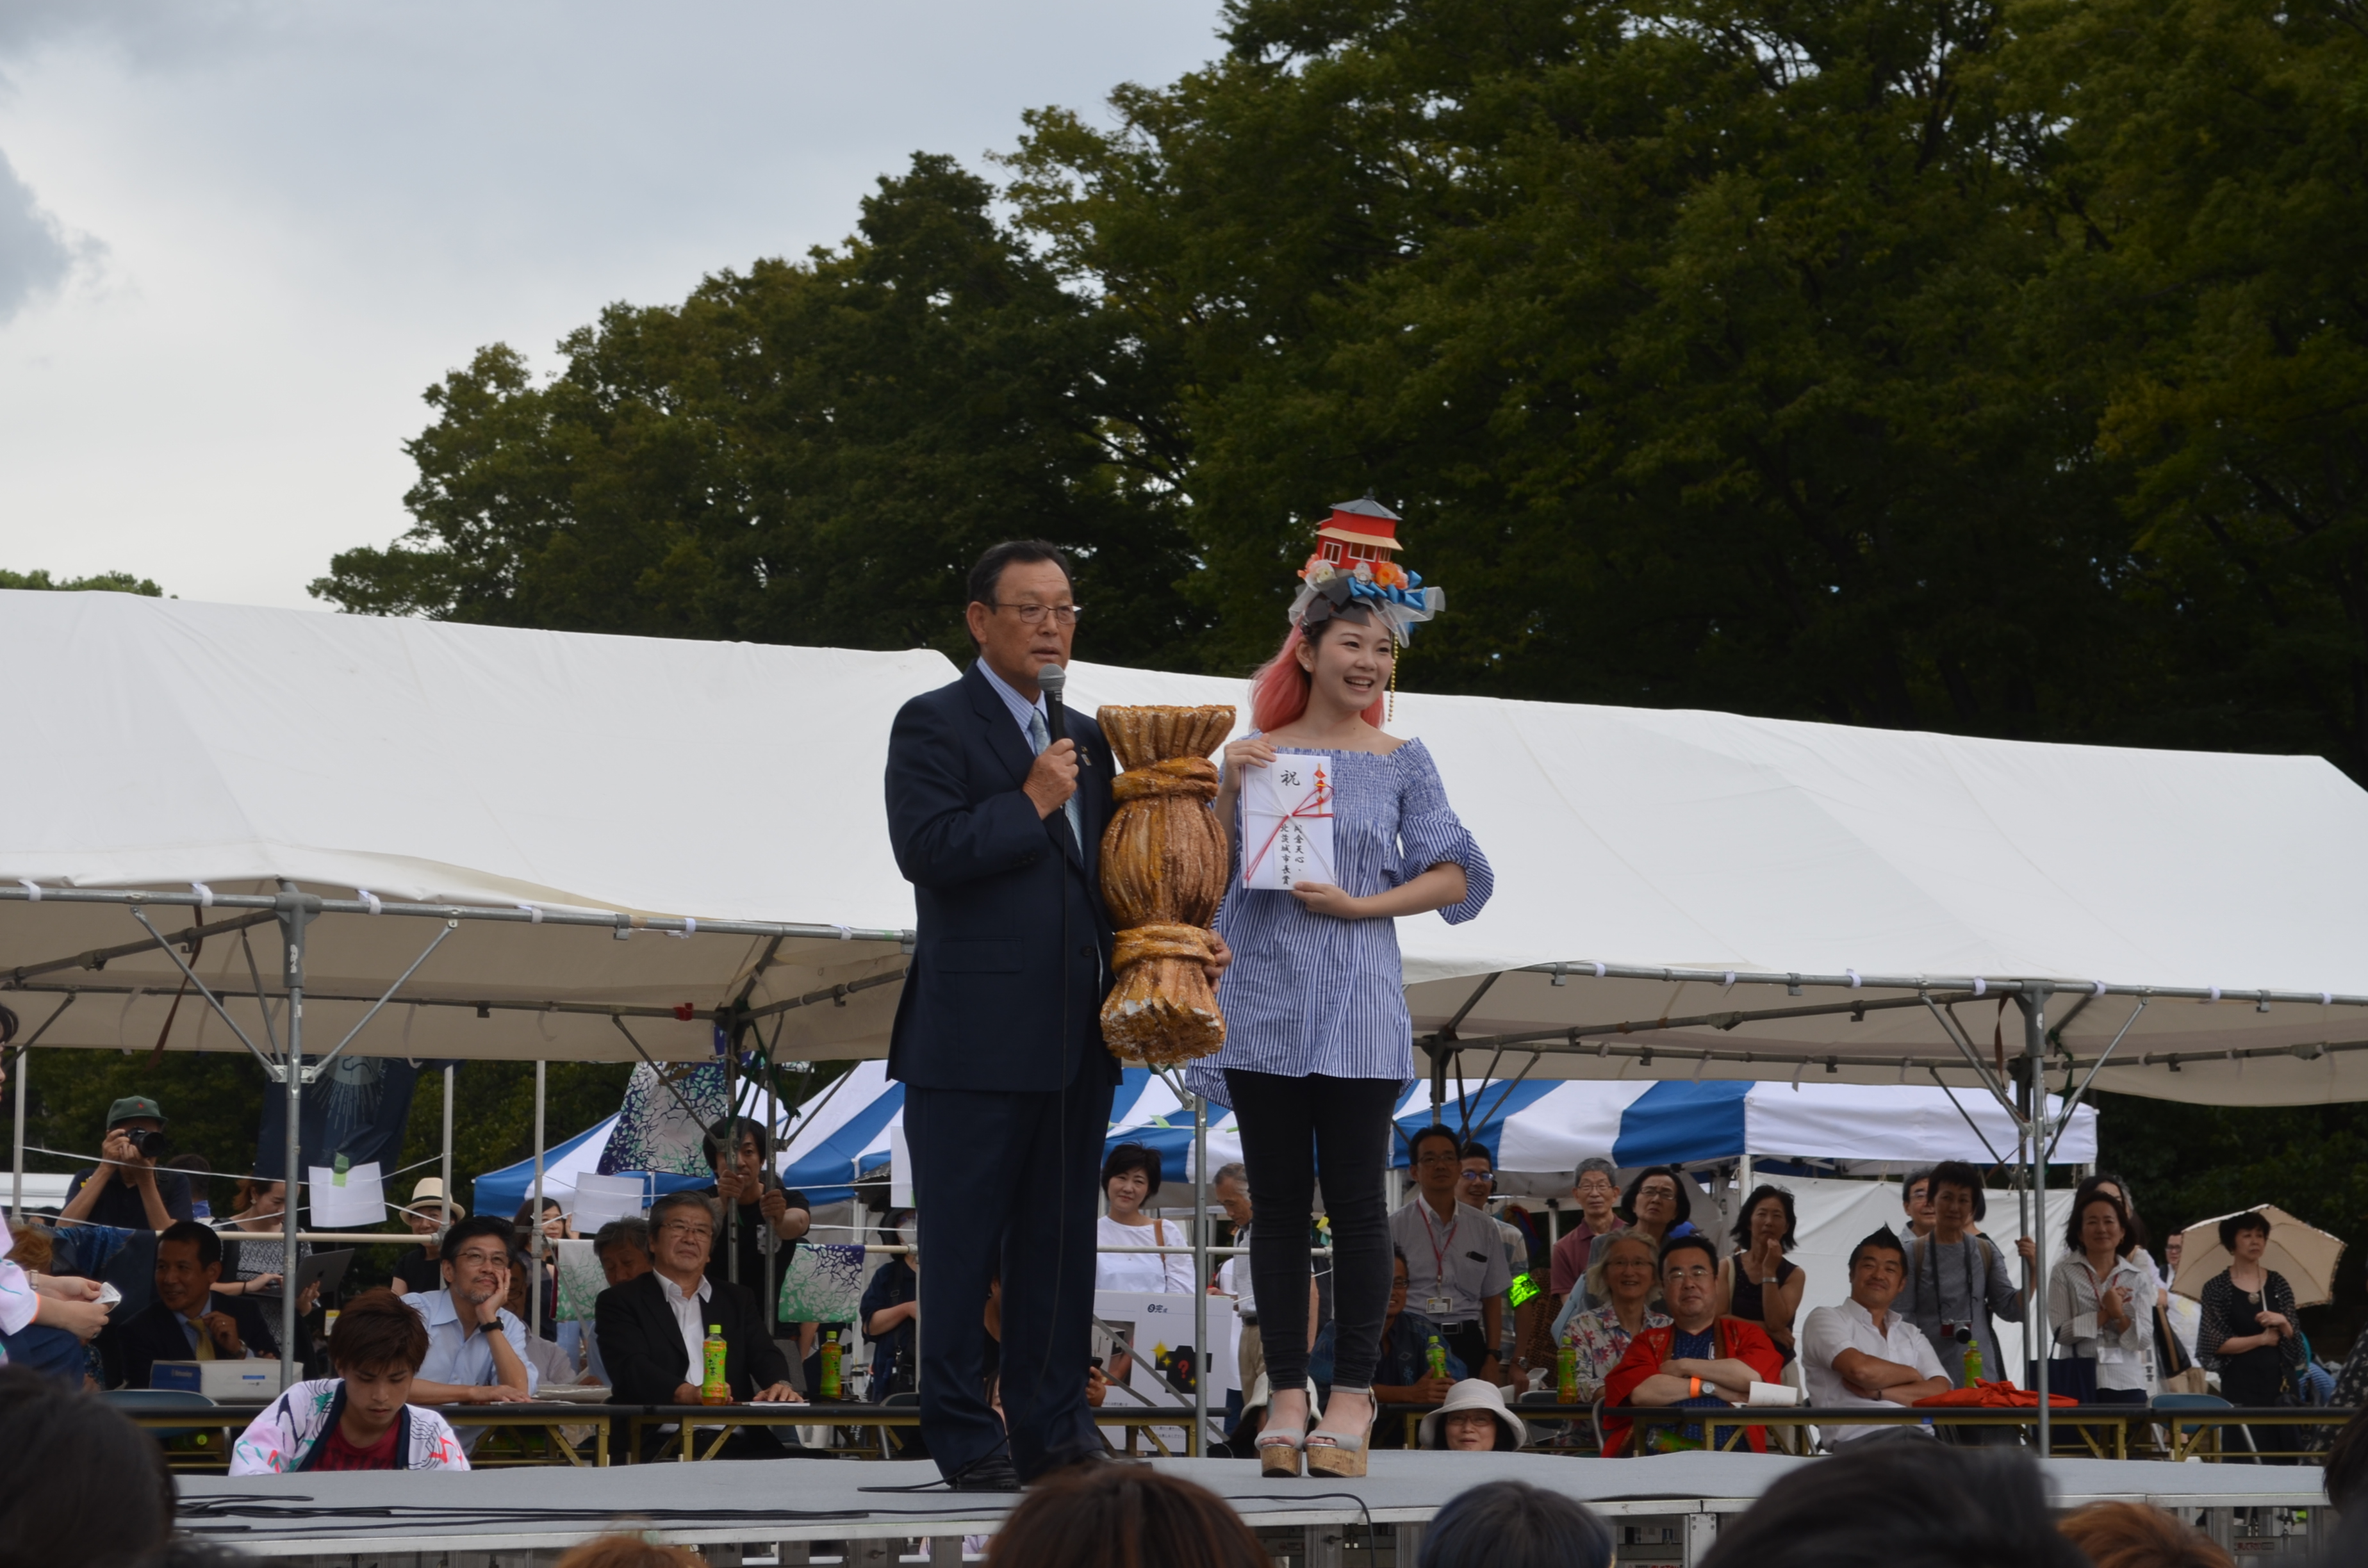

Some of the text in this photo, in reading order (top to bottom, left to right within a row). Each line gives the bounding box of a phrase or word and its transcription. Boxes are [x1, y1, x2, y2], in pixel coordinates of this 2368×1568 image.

[1280, 769, 1301, 787] 祝
[1280, 824, 1292, 886] 北茨城市長賞
